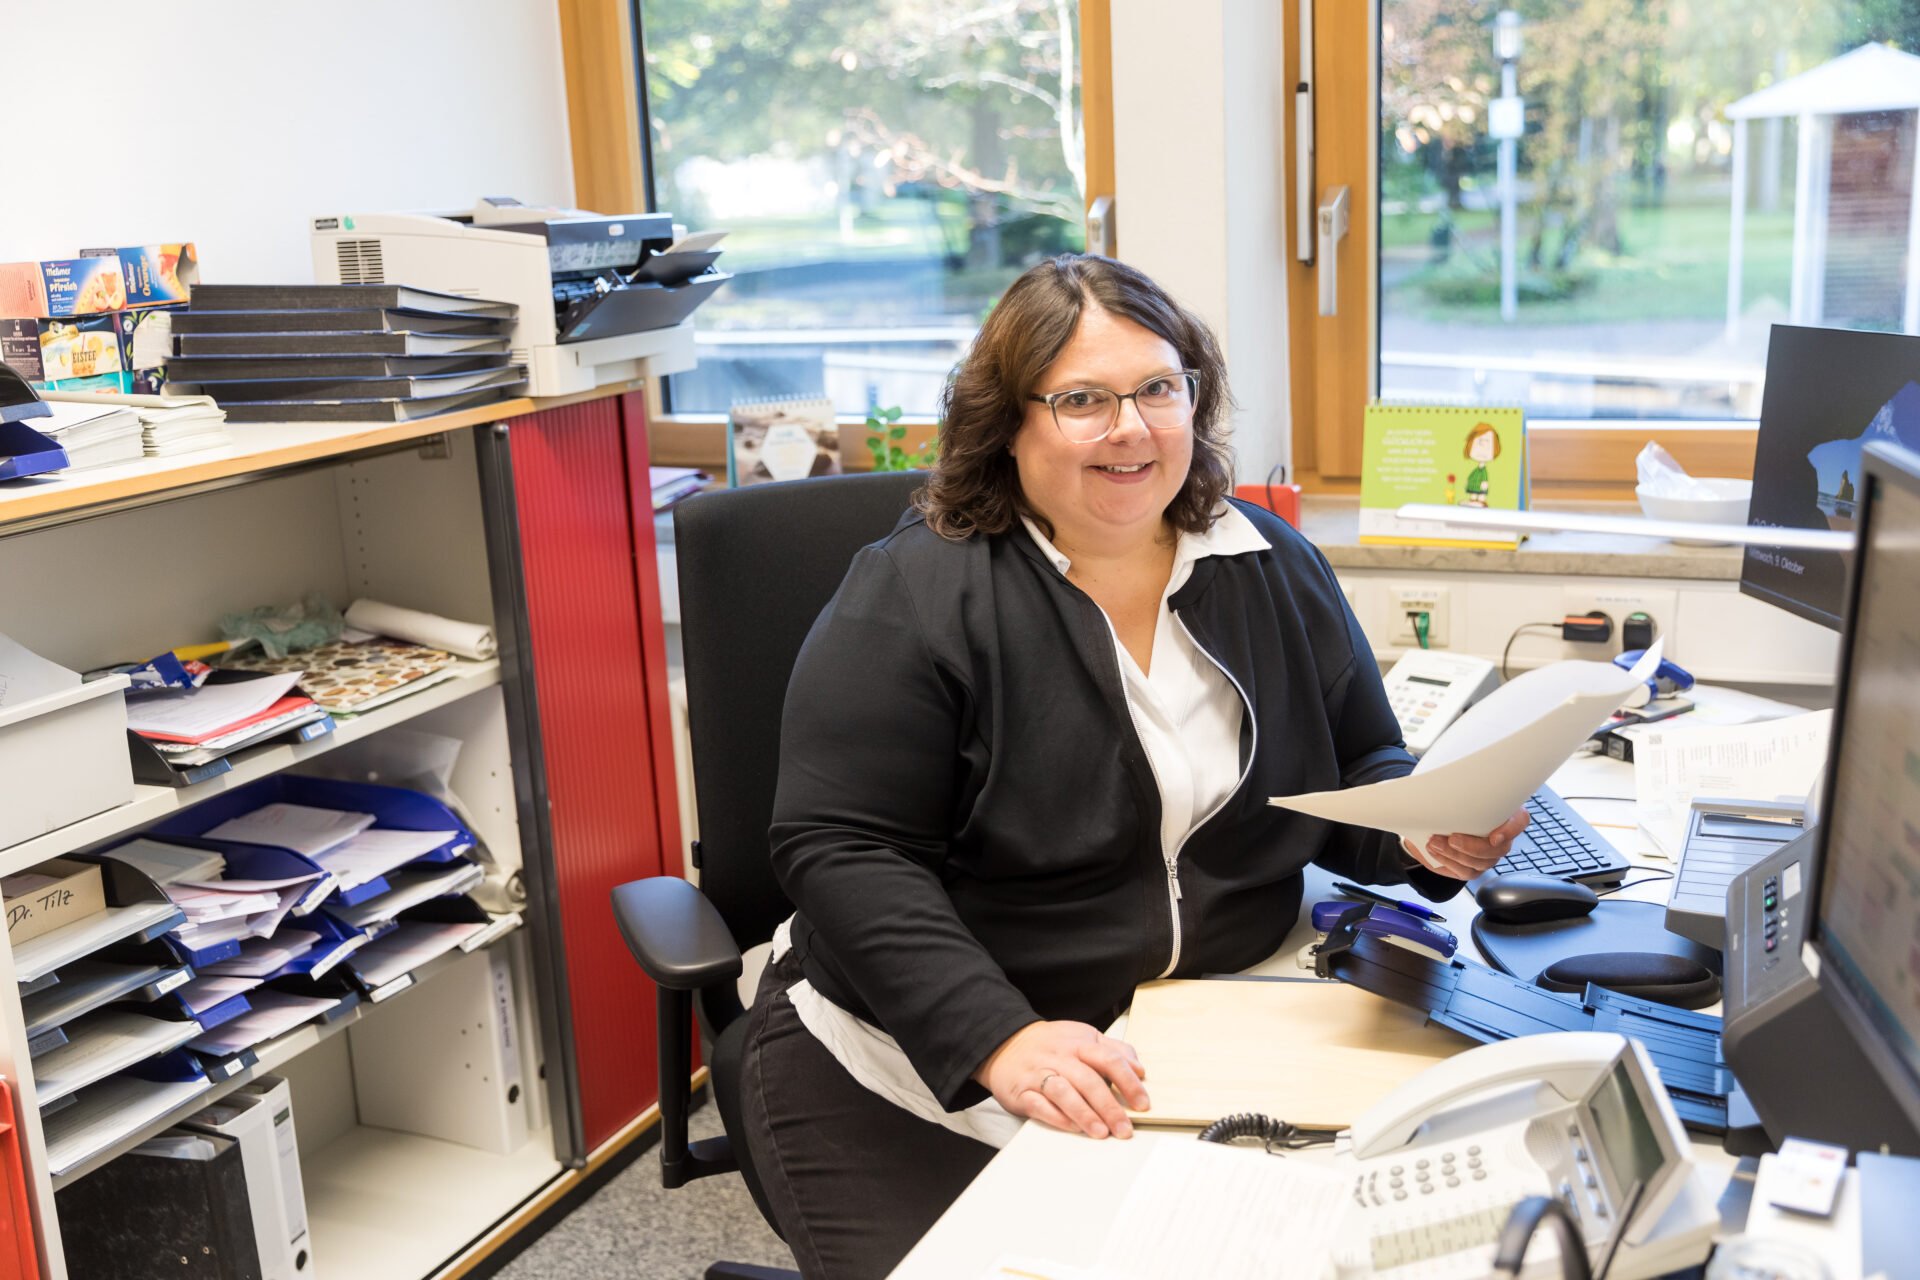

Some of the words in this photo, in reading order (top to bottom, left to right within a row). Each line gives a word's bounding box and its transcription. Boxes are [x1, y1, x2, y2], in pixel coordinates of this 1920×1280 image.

[140, 255, 151, 297] Orange
[72, 350, 97, 364] EISTEE
[1781, 556, 1805, 575] Oktober
[7, 904, 33, 933] Dr.
